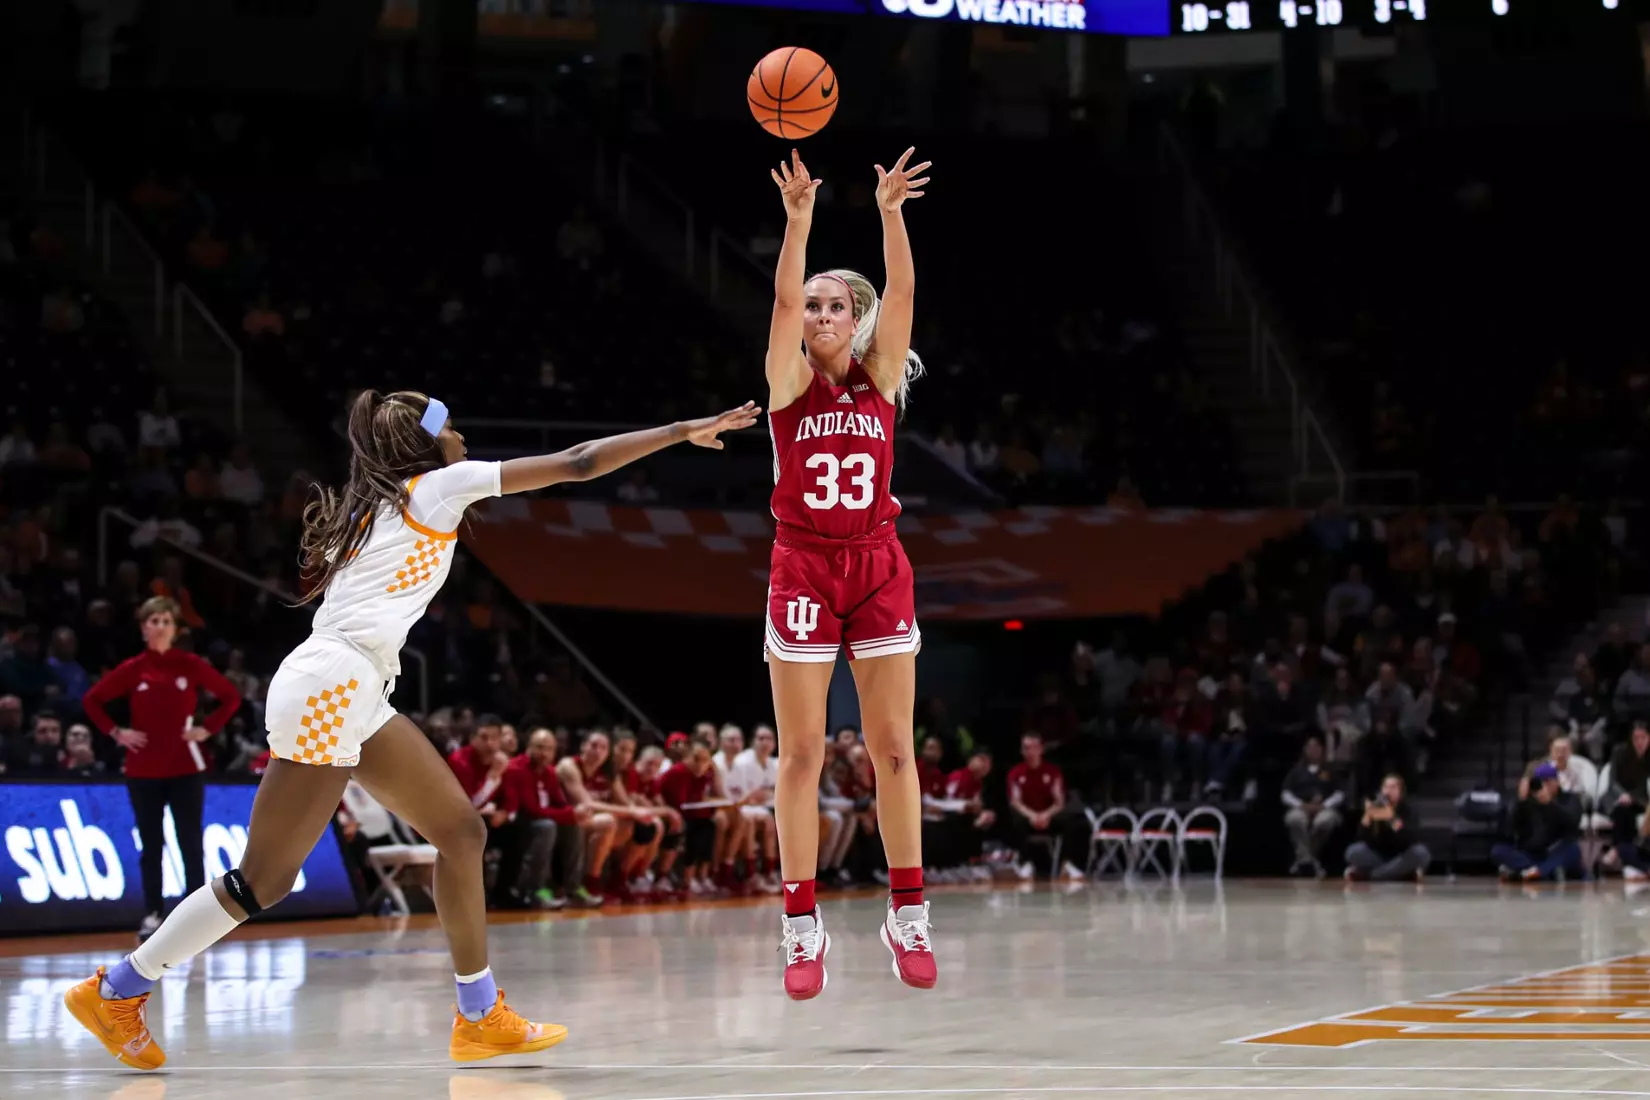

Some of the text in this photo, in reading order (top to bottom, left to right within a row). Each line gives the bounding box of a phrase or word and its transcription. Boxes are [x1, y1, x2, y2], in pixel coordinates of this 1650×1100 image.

[955, 0, 1086, 30] WEATHER
[795, 411, 886, 442] INDIANA
[803, 452, 876, 510] 33
[4, 798, 126, 904] sub
